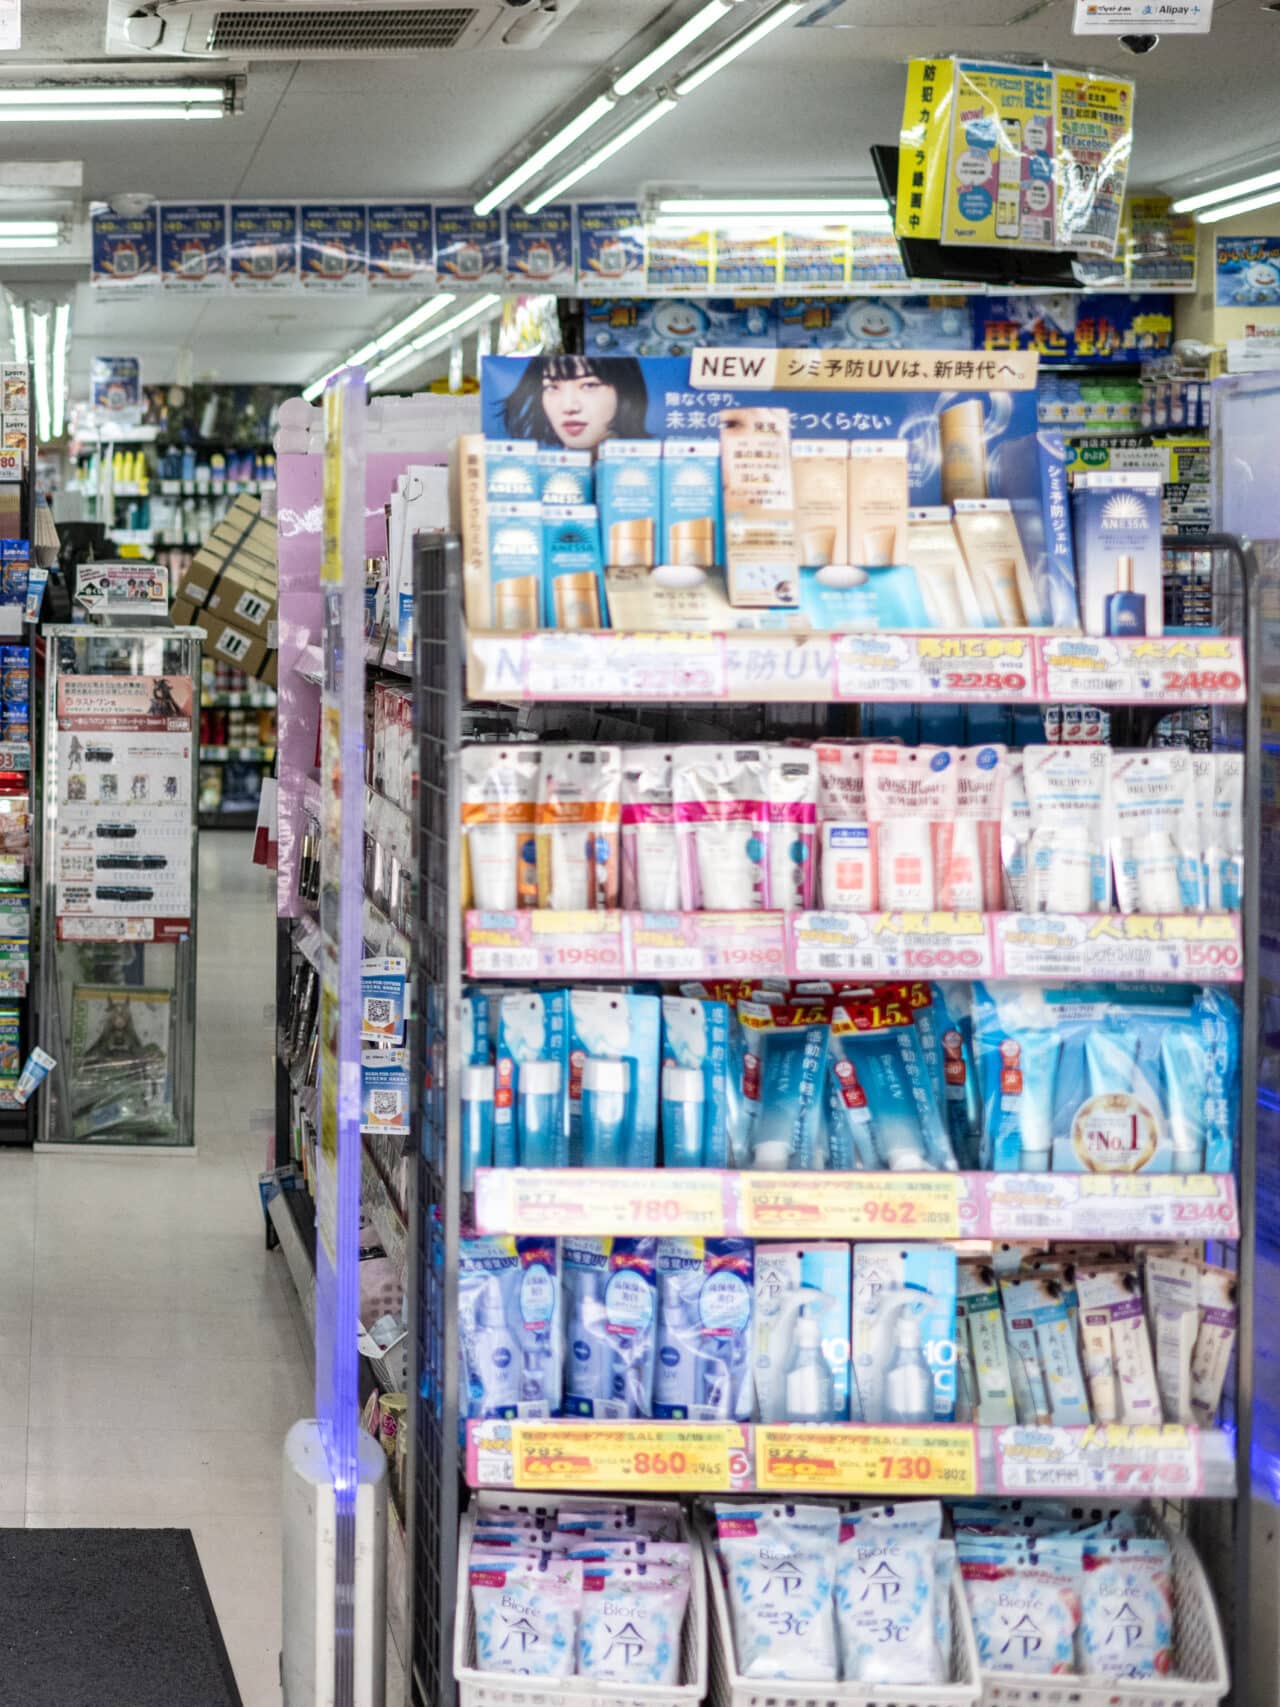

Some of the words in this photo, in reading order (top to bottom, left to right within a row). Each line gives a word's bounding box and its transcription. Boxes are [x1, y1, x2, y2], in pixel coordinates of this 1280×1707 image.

[1159, 5, 1189, 15] Alipay
[908, 64, 937, 231] 防犯カラ録画中
[700, 356, 766, 378] NEW
[786, 358, 1026, 380] シミ予防UVは、新時代へ。
[1100, 519, 1149, 530] ANESSA
[946, 673, 1027, 691] 2280
[1163, 671, 1241, 690] 2480
[557, 948, 618, 965] 1980
[721, 948, 783, 965] 1980
[1184, 945, 1239, 966] 1500
[1096, 1114, 1140, 1151] No.1
[863, 1202, 917, 1224] 962
[634, 1452, 687, 1475] 860
[879, 1456, 933, 1480] 730
[760, 1561, 804, 1597] 冷
[858, 1560, 902, 1602] 冷
[500, 1614, 539, 1653] 冷
[1000, 1613, 1044, 1659] 冷
[1104, 1601, 1144, 1649] 冷
[602, 1621, 648, 1666] 冷
